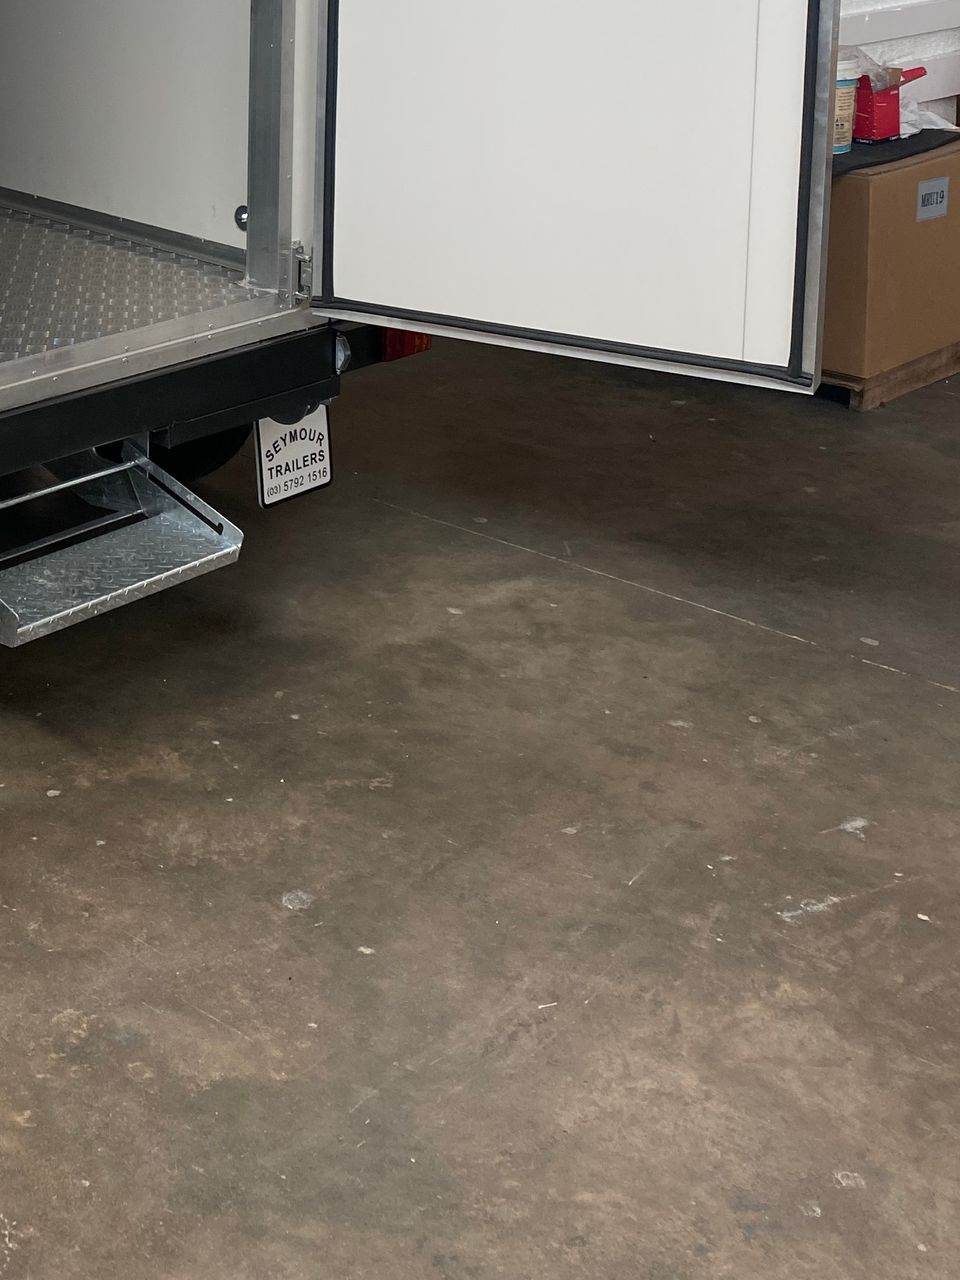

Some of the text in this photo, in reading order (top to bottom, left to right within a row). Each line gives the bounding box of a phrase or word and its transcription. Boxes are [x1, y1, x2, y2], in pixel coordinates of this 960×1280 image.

[265, 427, 325, 462] SEYMOUR
[267, 450, 325, 479] TRAILERS
[266, 467, 328, 498] (03) 5792 1516
